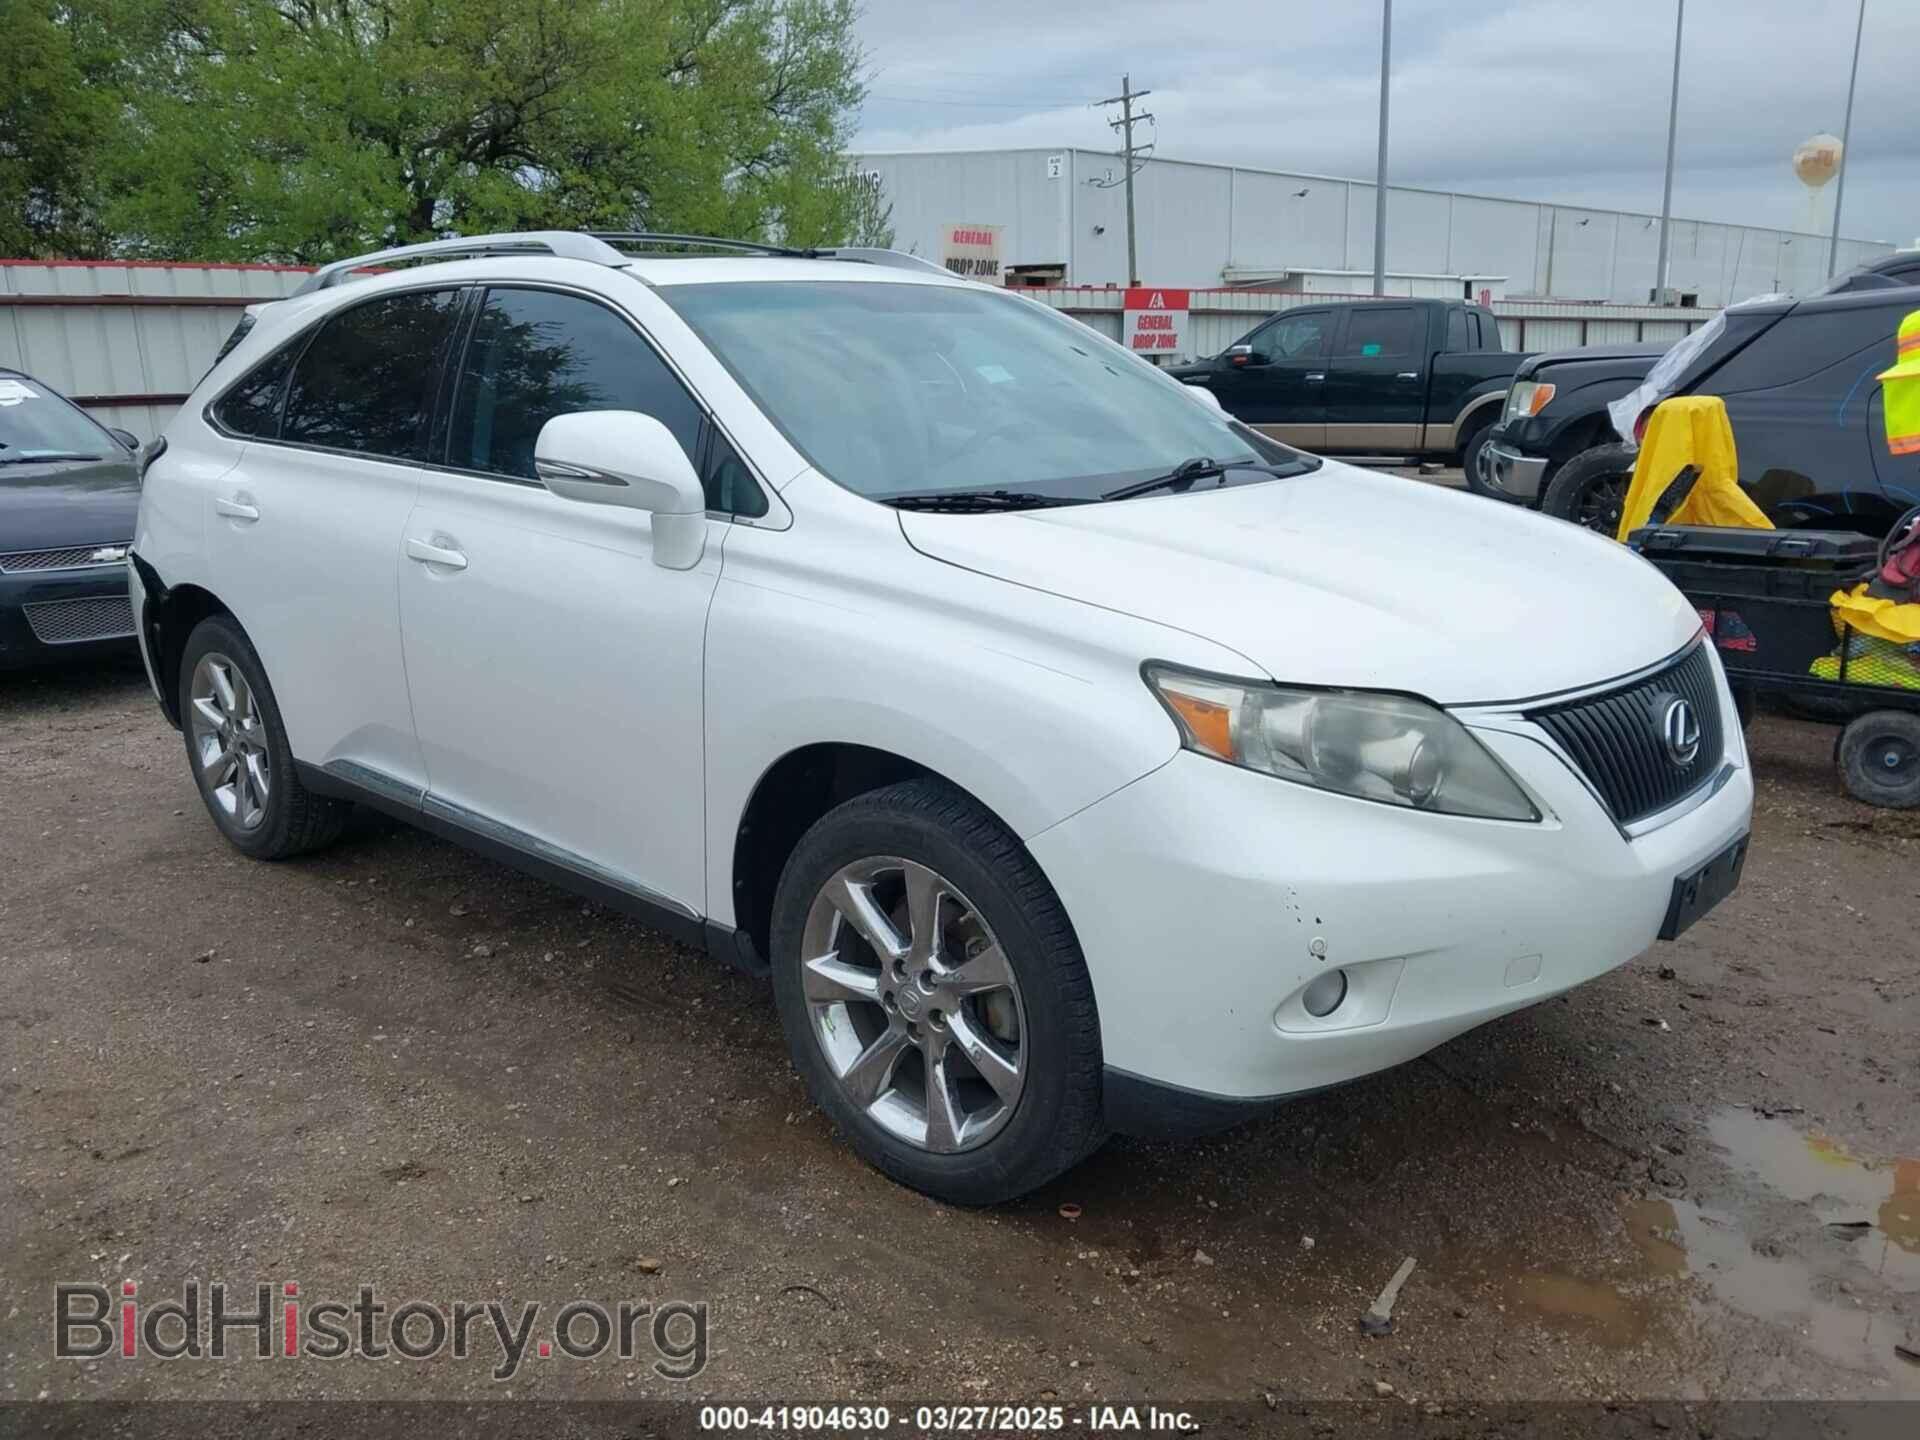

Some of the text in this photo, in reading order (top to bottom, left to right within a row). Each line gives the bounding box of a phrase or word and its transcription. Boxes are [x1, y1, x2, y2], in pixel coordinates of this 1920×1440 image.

[953, 230, 992, 246] GENERAL
[945, 257, 999, 276] DROP ZONE
[1137, 315, 1173, 330] GENERAL
[1132, 333, 1178, 349] DROP ZONE
